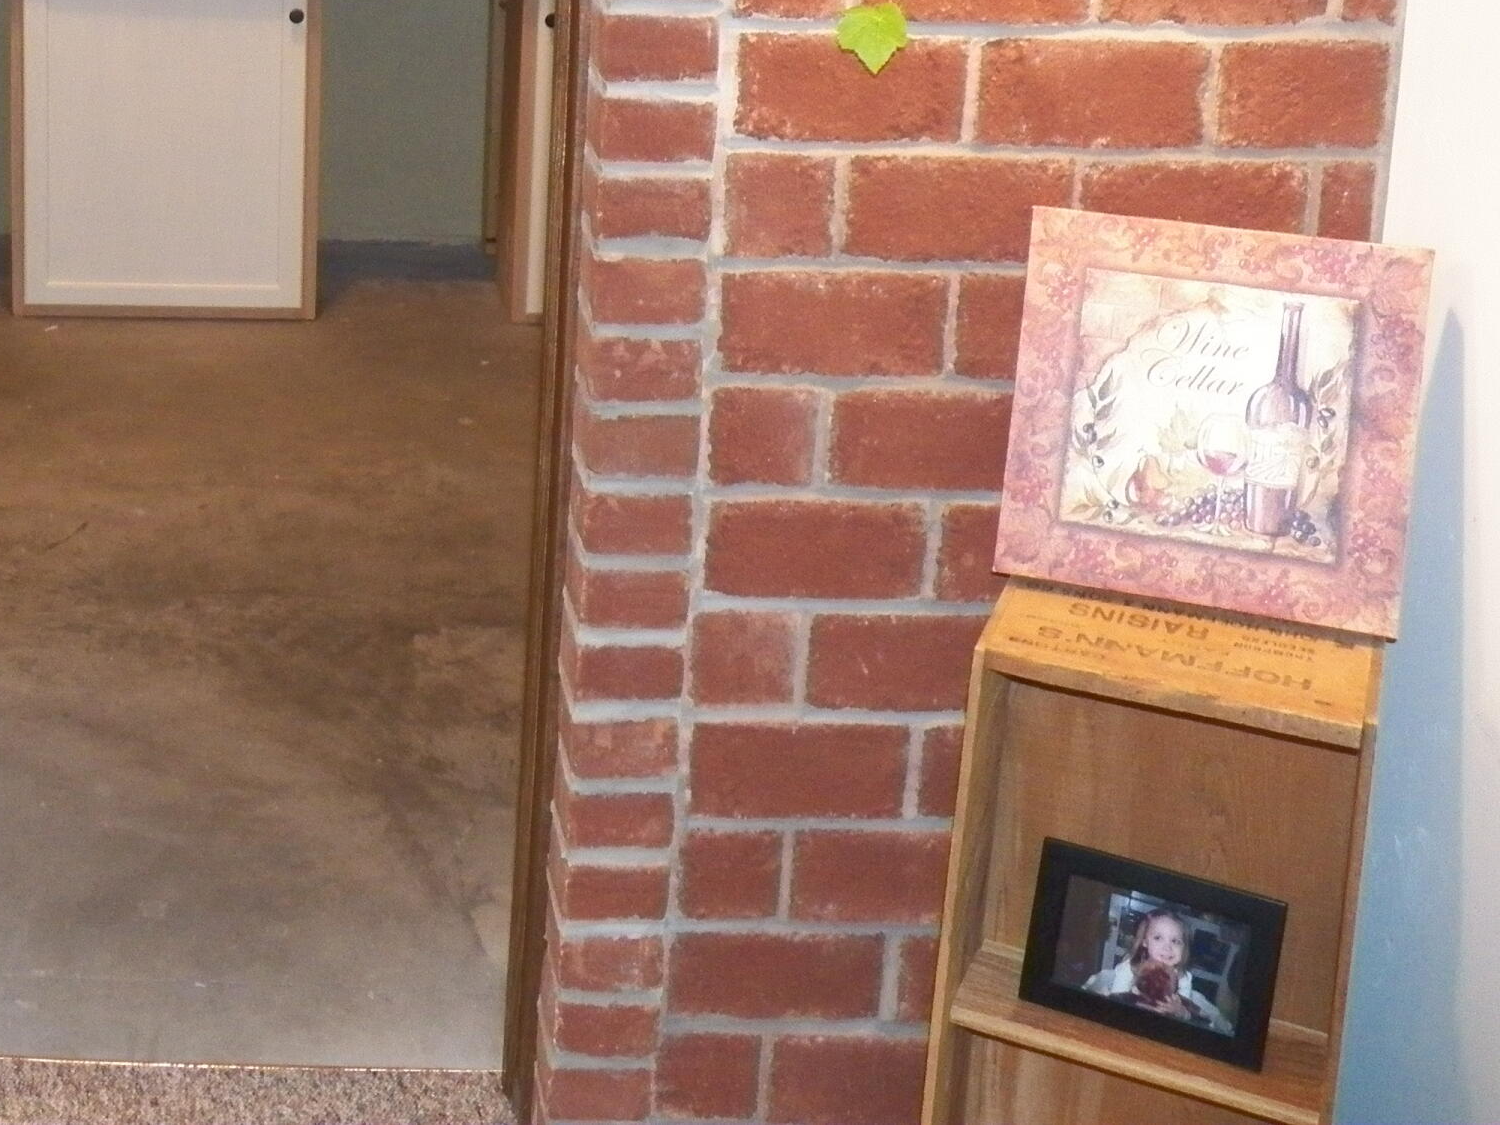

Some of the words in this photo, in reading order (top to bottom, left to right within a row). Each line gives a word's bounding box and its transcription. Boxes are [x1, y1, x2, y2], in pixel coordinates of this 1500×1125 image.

[1156, 320, 1250, 358] Wine
[1140, 348, 1244, 395] Cellar
[1067, 602, 1209, 640] RAISINS
[1037, 625, 1312, 690] HOFFMANN'S
